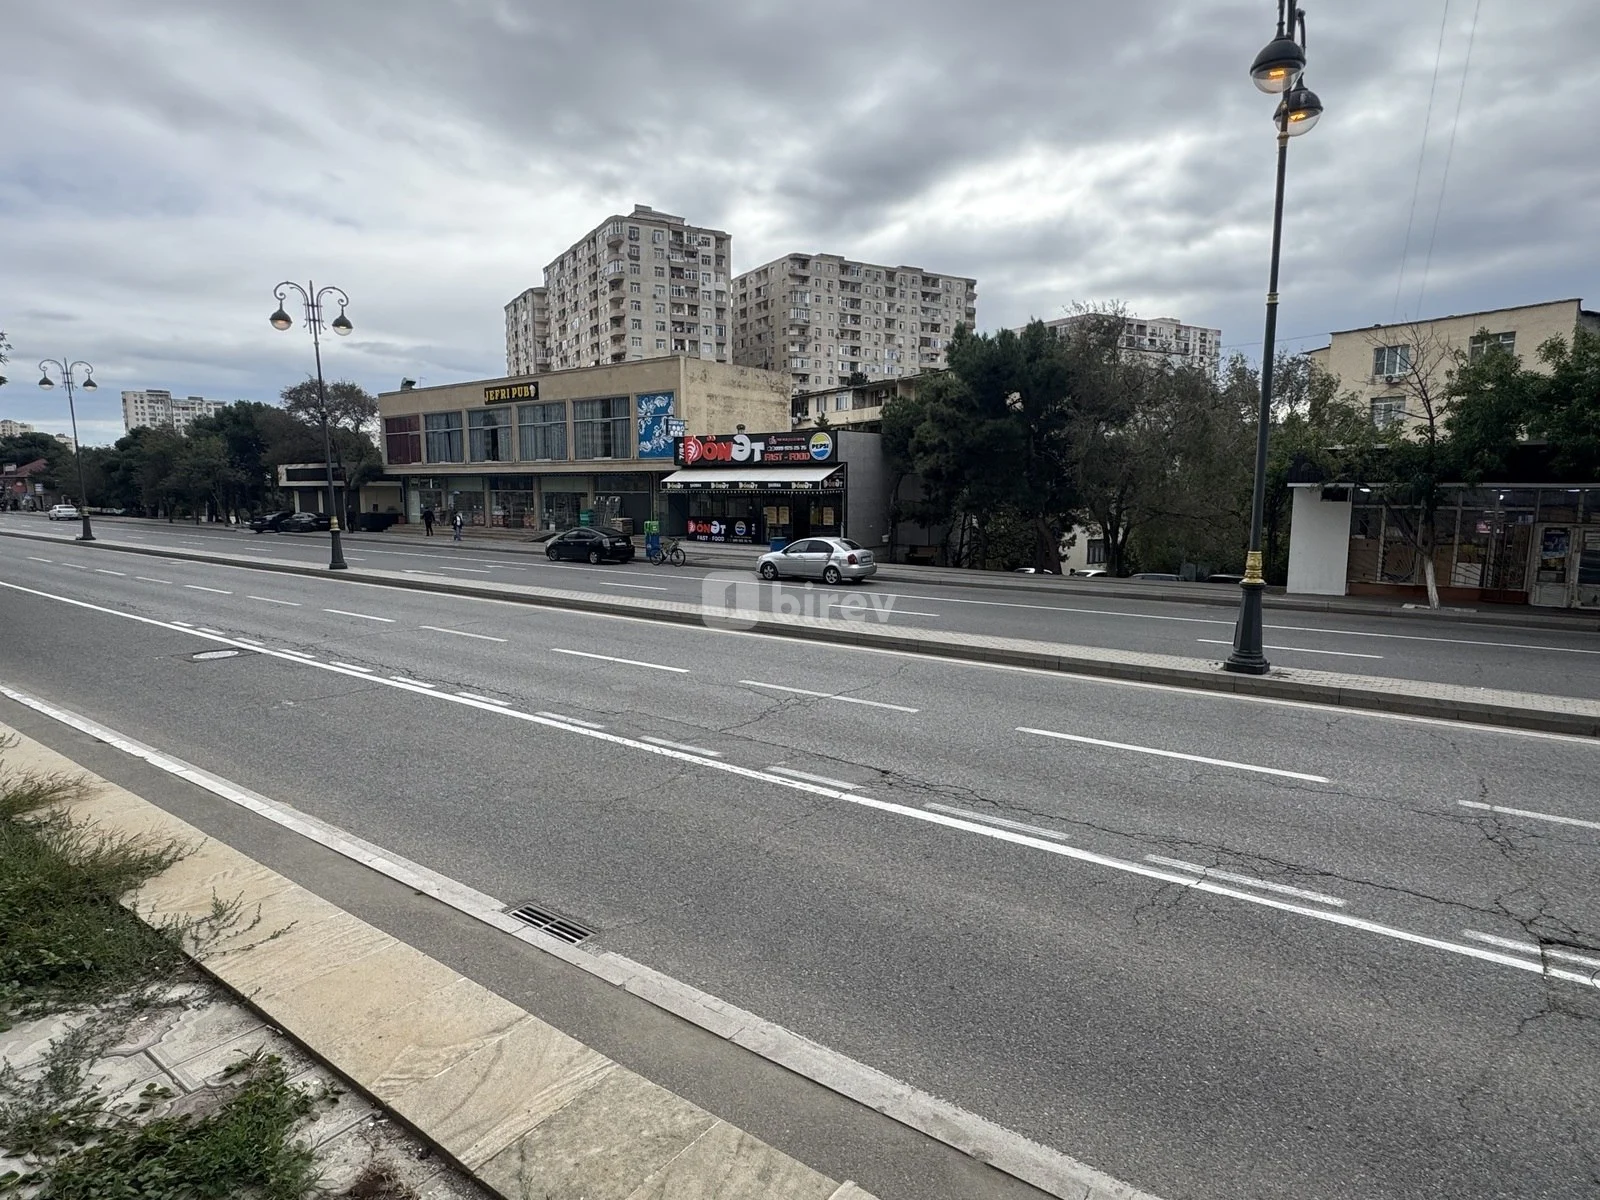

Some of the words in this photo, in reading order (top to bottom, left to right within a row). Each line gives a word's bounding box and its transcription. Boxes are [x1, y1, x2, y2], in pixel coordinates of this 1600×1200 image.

[485, 388, 510, 402] JEFRI
[511, 386, 530, 399] PUB
[764, 452, 783, 461] FAST
[789, 452, 810, 460] FOOD
